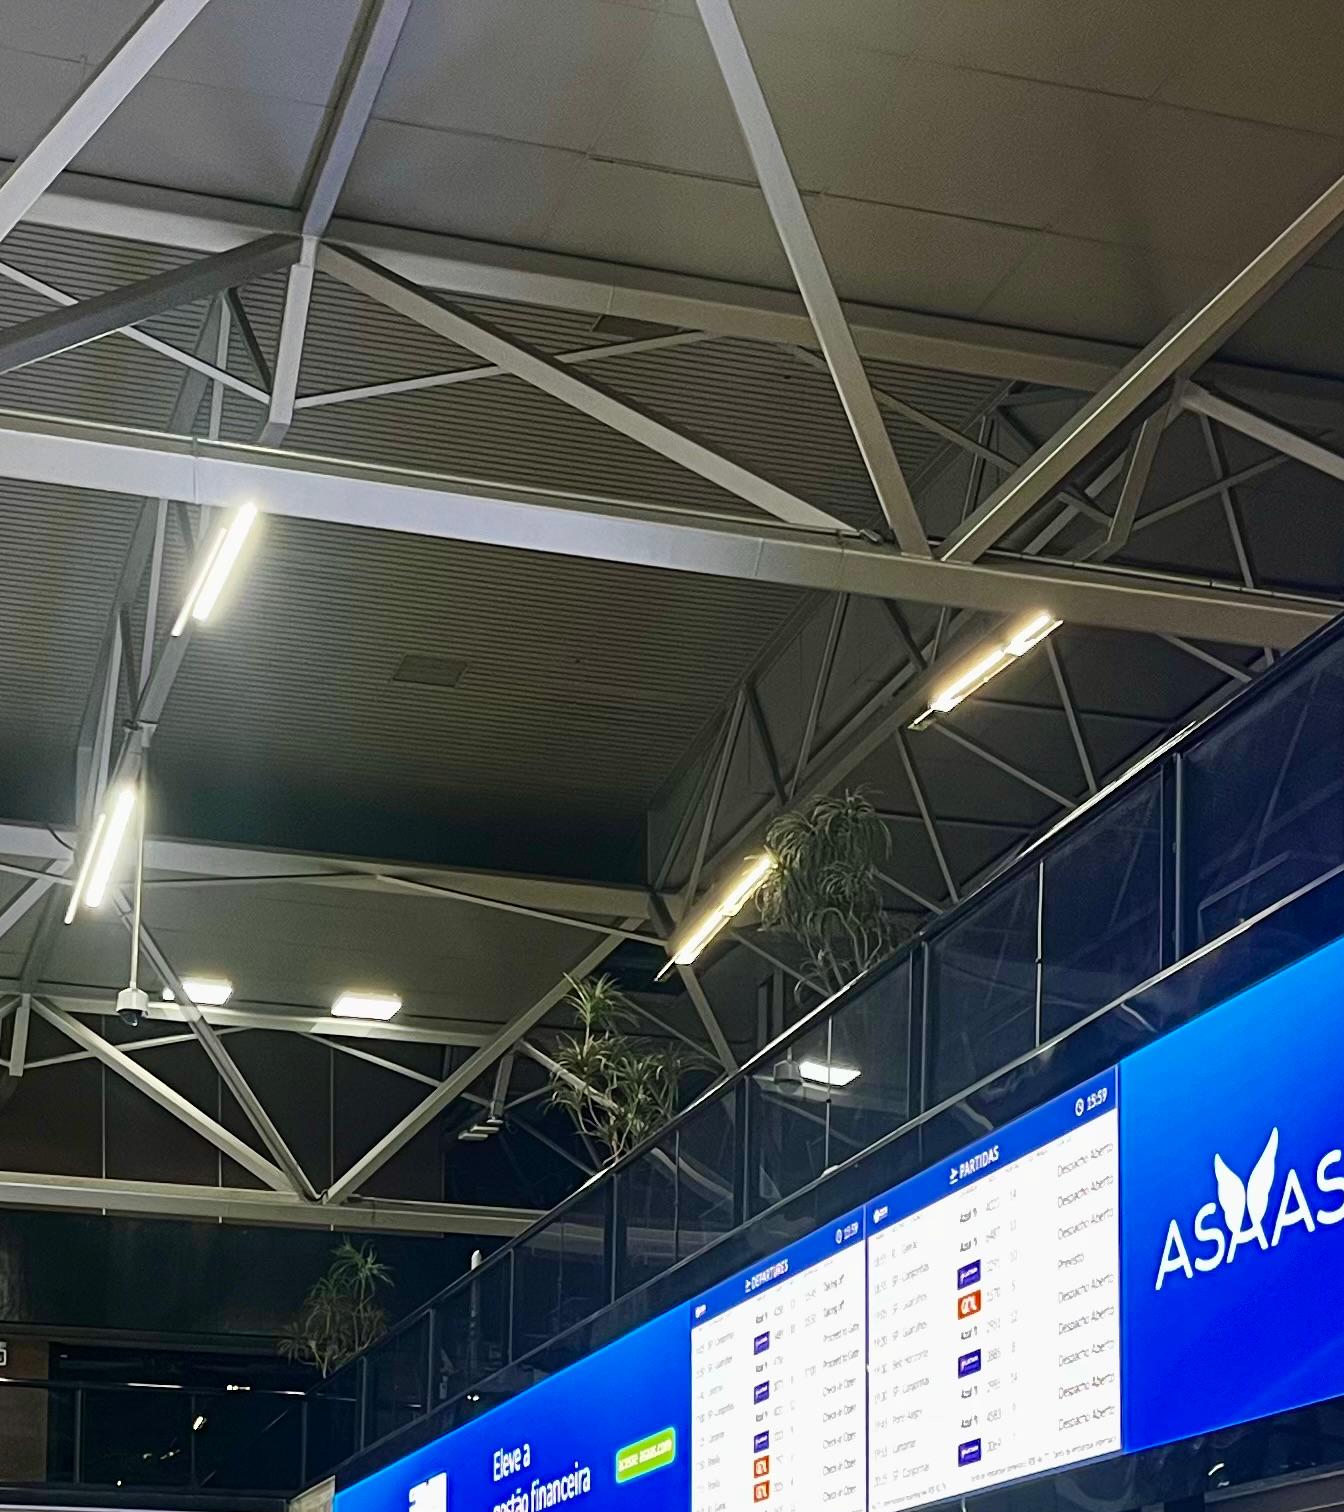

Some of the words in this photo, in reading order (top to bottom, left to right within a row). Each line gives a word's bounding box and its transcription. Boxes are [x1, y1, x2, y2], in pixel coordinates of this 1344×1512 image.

[959, 1145, 1000, 1180] PARTIDAS
[493, 1447, 523, 1482] Eleve
[523, 1443, 531, 1467] a
